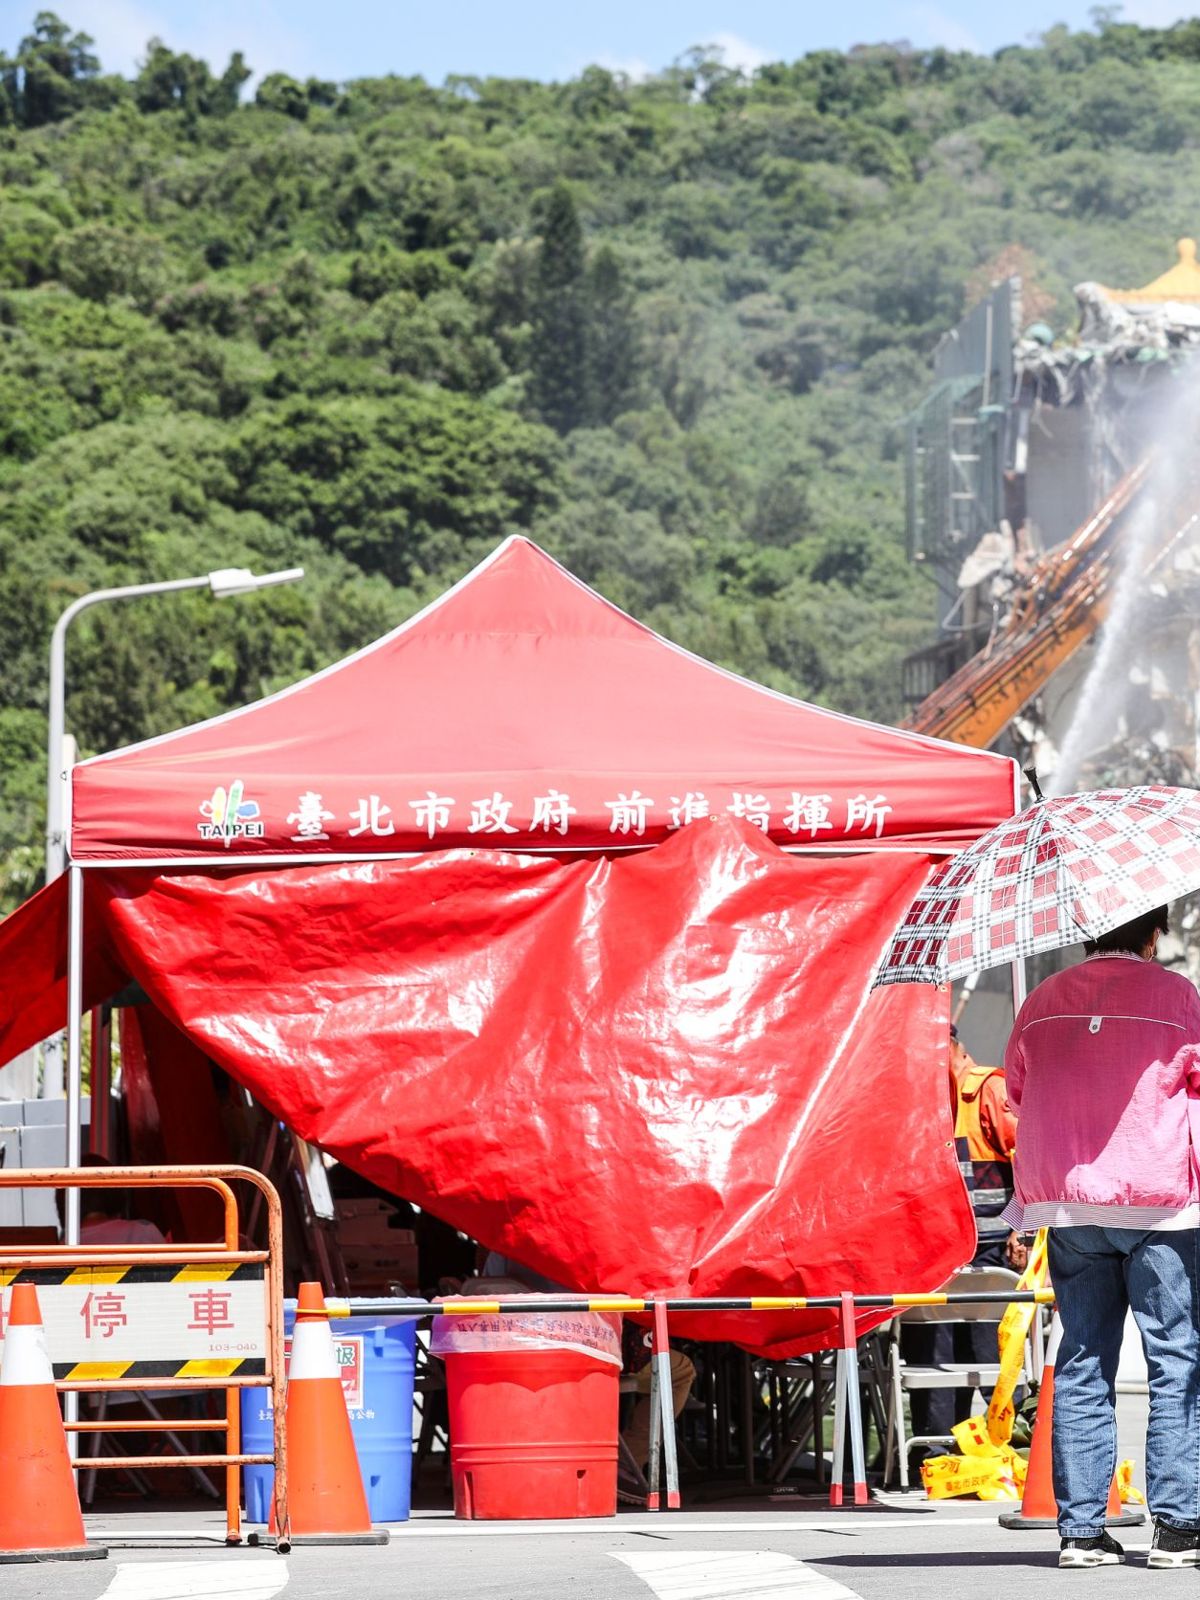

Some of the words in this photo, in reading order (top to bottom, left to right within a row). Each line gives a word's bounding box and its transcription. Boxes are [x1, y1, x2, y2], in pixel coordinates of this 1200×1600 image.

[199, 823, 264, 838] TAIPEI
[286, 789, 577, 842] 臺北市政府
[604, 789, 893, 838] 前進指揮所
[0, 1288, 235, 1339] 停車
